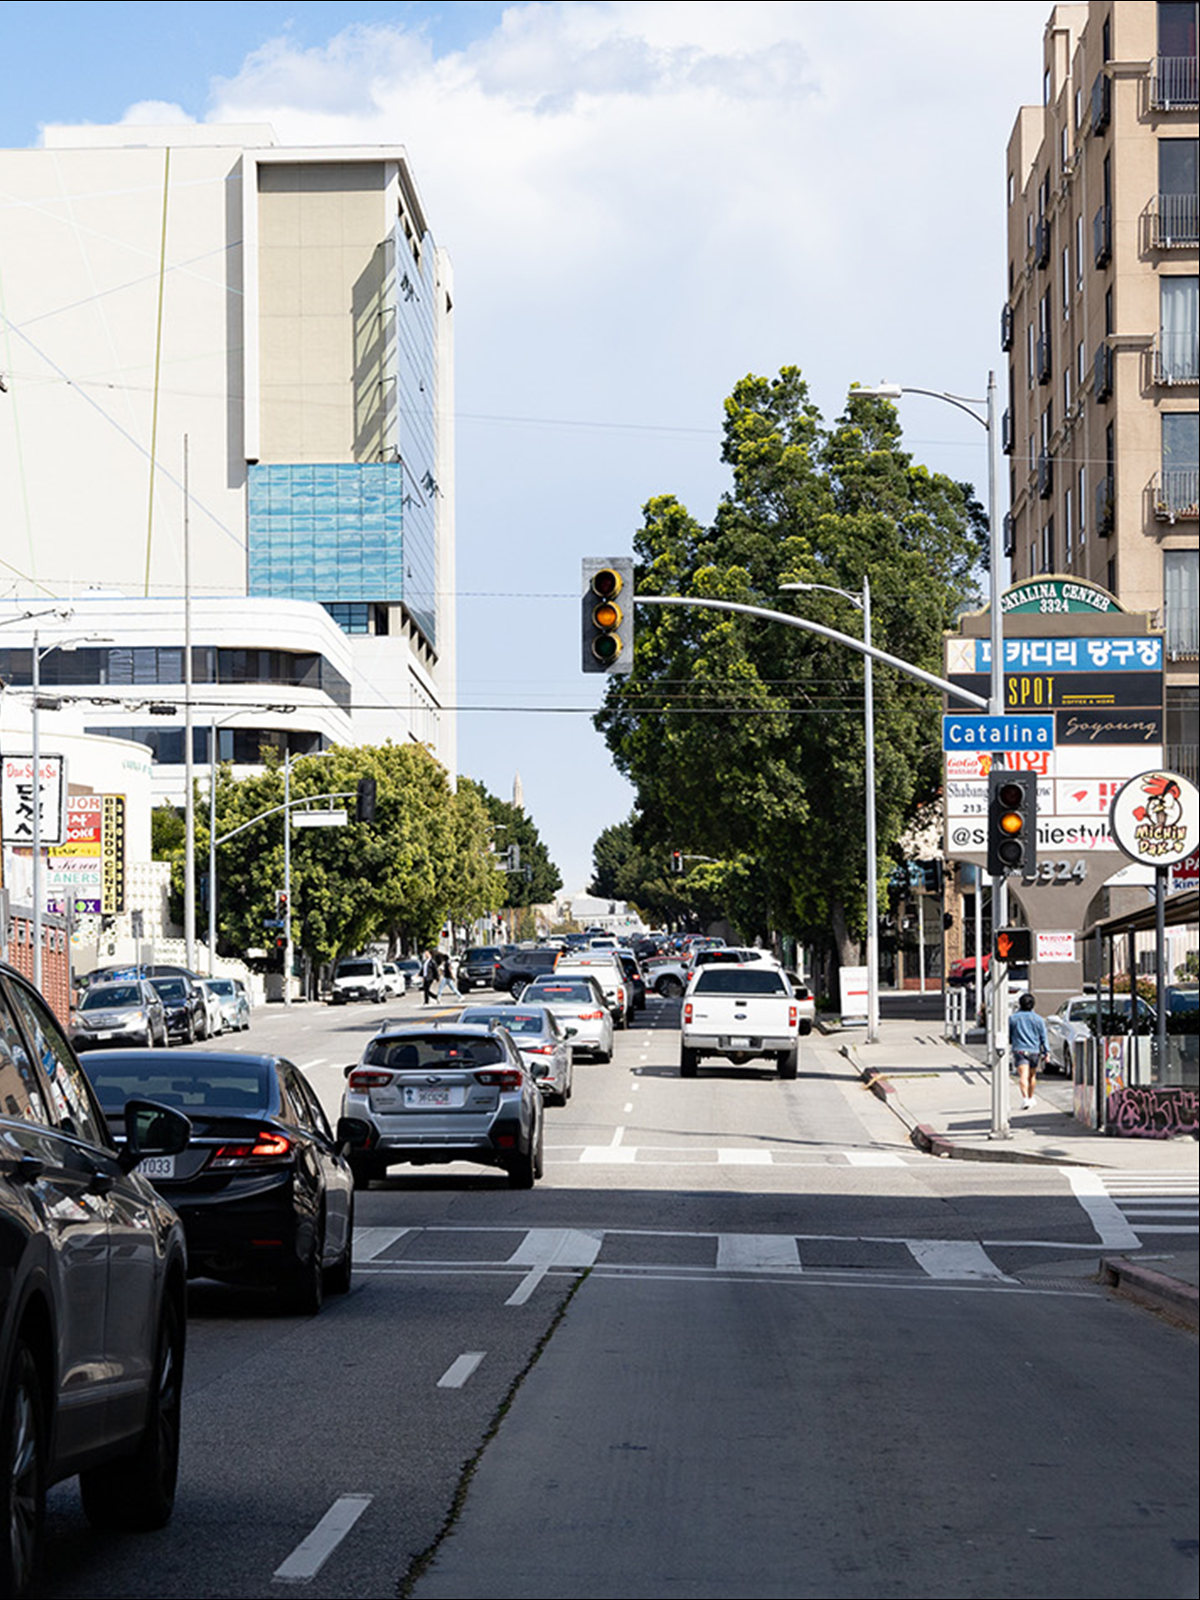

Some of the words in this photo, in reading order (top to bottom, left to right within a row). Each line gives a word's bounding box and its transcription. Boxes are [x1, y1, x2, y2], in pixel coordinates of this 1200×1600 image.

[999, 583, 1058, 613] CATALINA
[1061, 583, 1111, 612] CENTER
[1039, 599, 1070, 613] 3324
[1087, 640, 1161, 667] 당구장
[1008, 677, 1055, 705] SPOT
[949, 724, 1049, 743] Catalina
[104, 798, 114, 857] BERENDO
[104, 860, 114, 910] CENTER
